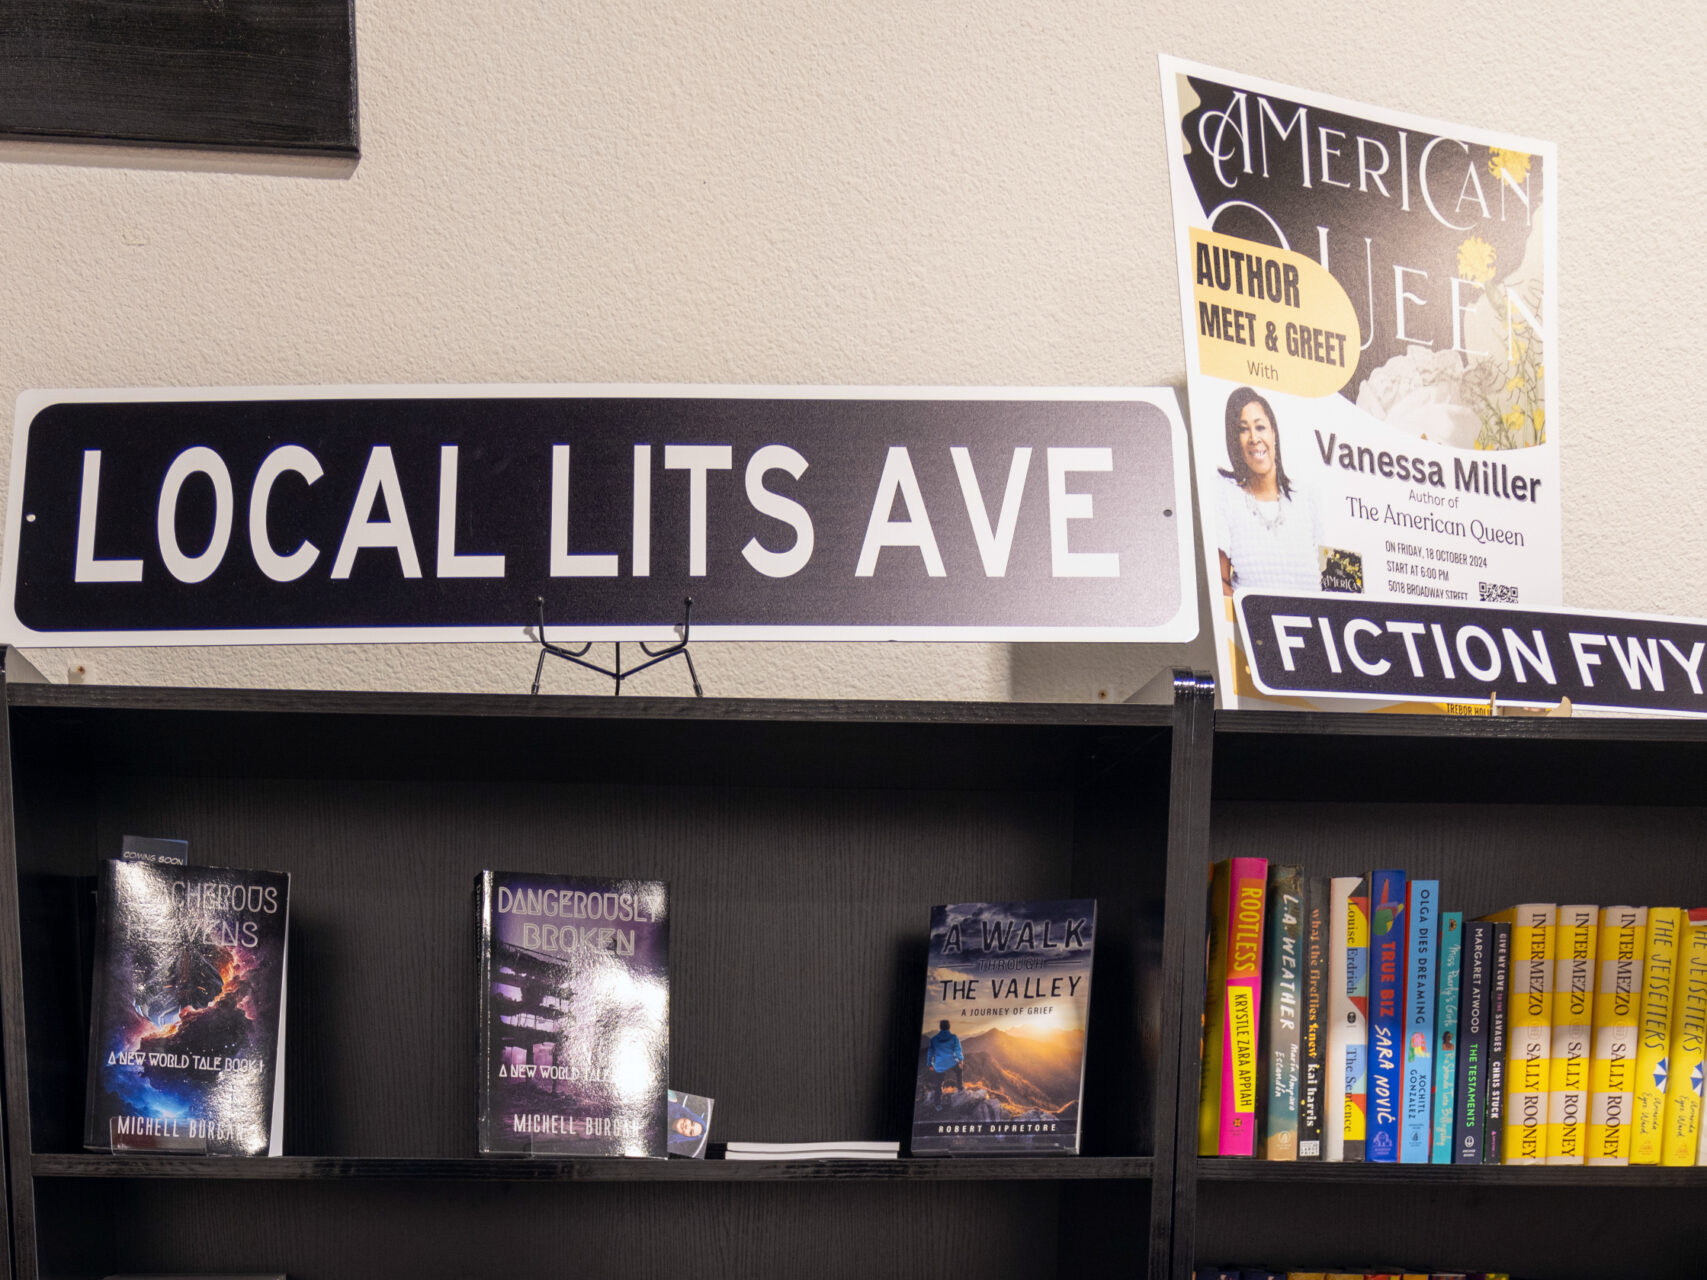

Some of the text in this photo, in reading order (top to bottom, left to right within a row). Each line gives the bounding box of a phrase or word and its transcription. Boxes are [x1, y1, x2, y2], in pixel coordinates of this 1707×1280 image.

[1199, 90, 1532, 231] AMERICAN
[1195, 241, 1301, 308] AUTHOR
[1199, 300, 1347, 368] MEET & GREET
[1247, 359, 1279, 382] With
[1314, 429, 1541, 503] Vanessa Miller
[74, 444, 1122, 583] LOCAL LITS AVE
[1409, 489, 1459, 508] Author of
[1346, 496, 1525, 547] The American Queen
[1386, 540, 1487, 568] ON FRIDAY, 18 OCTOBER 2024
[1387, 561, 1449, 581] START AT 6:00 PM
[1388, 580, 1405, 593] 5018
[1407, 583, 1443, 599] BROADWAY
[1271, 614, 1707, 696] FICTION FWY
[123, 850, 184, 866] COMING SOON
[498, 886, 659, 923] DANGEROUSLY
[523, 923, 635, 956] BROKEN
[943, 918, 1086, 954] A WALK
[1233, 887, 1262, 971] ROOTLESS
[978, 959, 1045, 972] THROUGH
[1416, 889, 1430, 1024] OLGA DIES DREAMING
[1528, 913, 1546, 1016] INTERMEZZO
[940, 975, 1082, 1001] THE VALLEY
[1380, 942, 1395, 1017] TRUE BIZ
[1471, 928, 1484, 1034] MARGARET ATWOOD
[970, 1008, 1009, 1016] JOURNEY
[1013, 1007, 1024, 1015] OF
[1027, 1006, 1054, 1015] GRIEF
[107, 1051, 116, 1064] A
[119, 1052, 146, 1066] NEW
[149, 1053, 189, 1068] WORLD
[193, 1055, 221, 1071] TALE
[1466, 1044, 1478, 1127] THE TESTAMENTS
[1522, 1043, 1541, 1158] SALLY ROONEY
[117, 1115, 179, 1138] MICHELL
[938, 1124, 1056, 1133] ROBERT DIPRETORE
